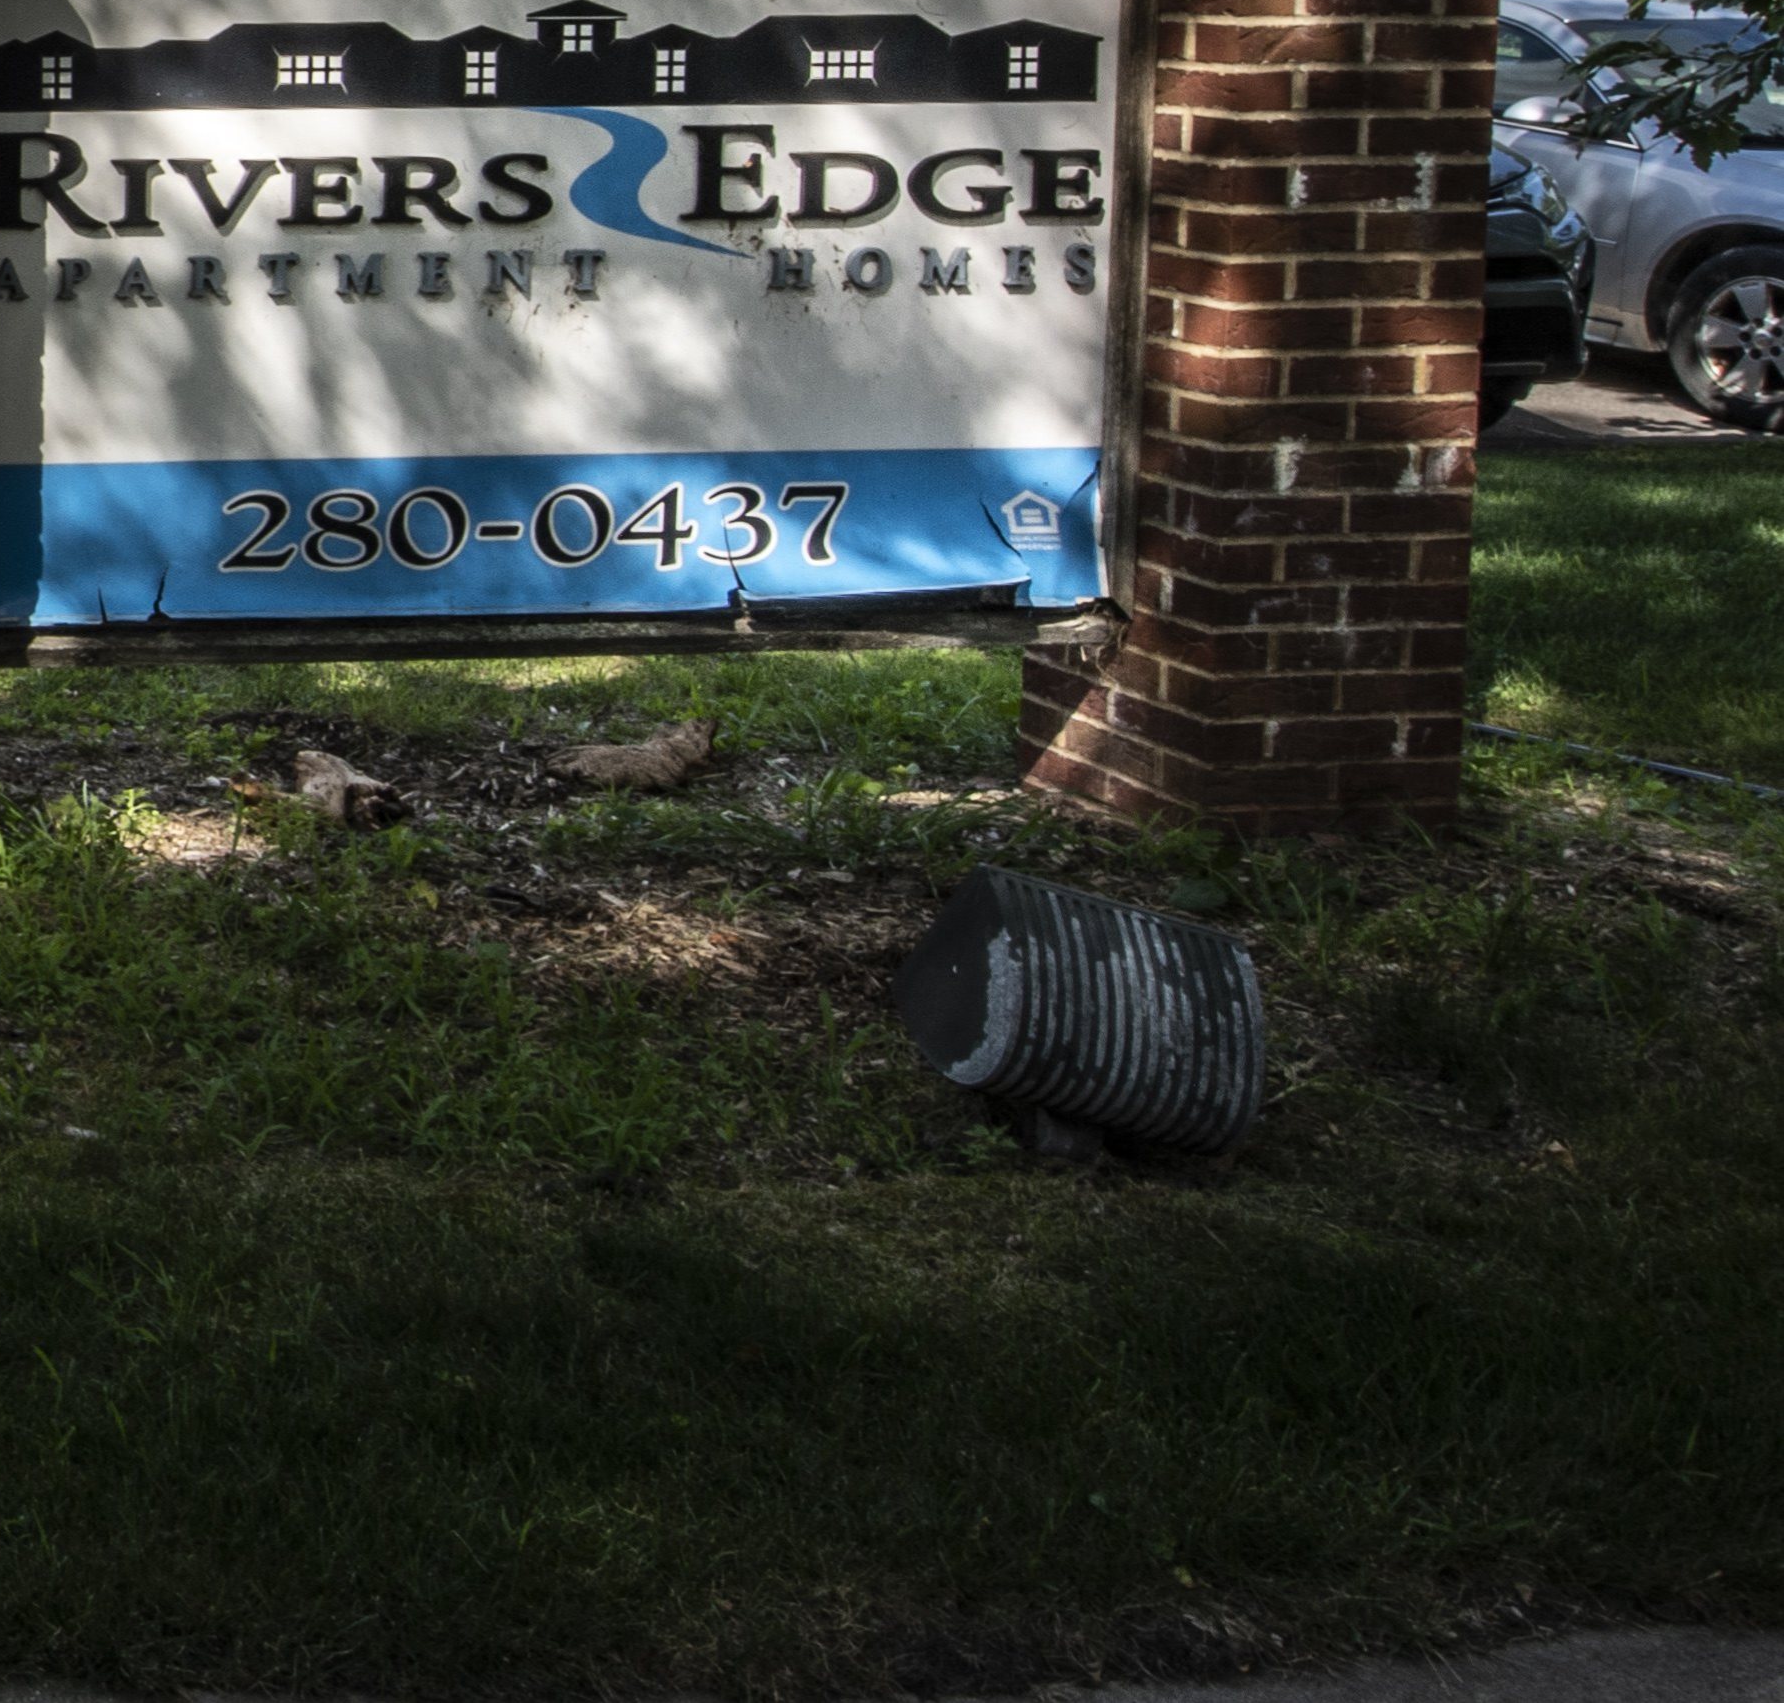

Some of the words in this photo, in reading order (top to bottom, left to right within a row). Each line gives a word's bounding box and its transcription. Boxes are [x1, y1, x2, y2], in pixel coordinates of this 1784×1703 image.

[679, 124, 1104, 224] EDGE
[767, 244, 1097, 295] HOMES
[219, 482, 849, 573] 280-0437
